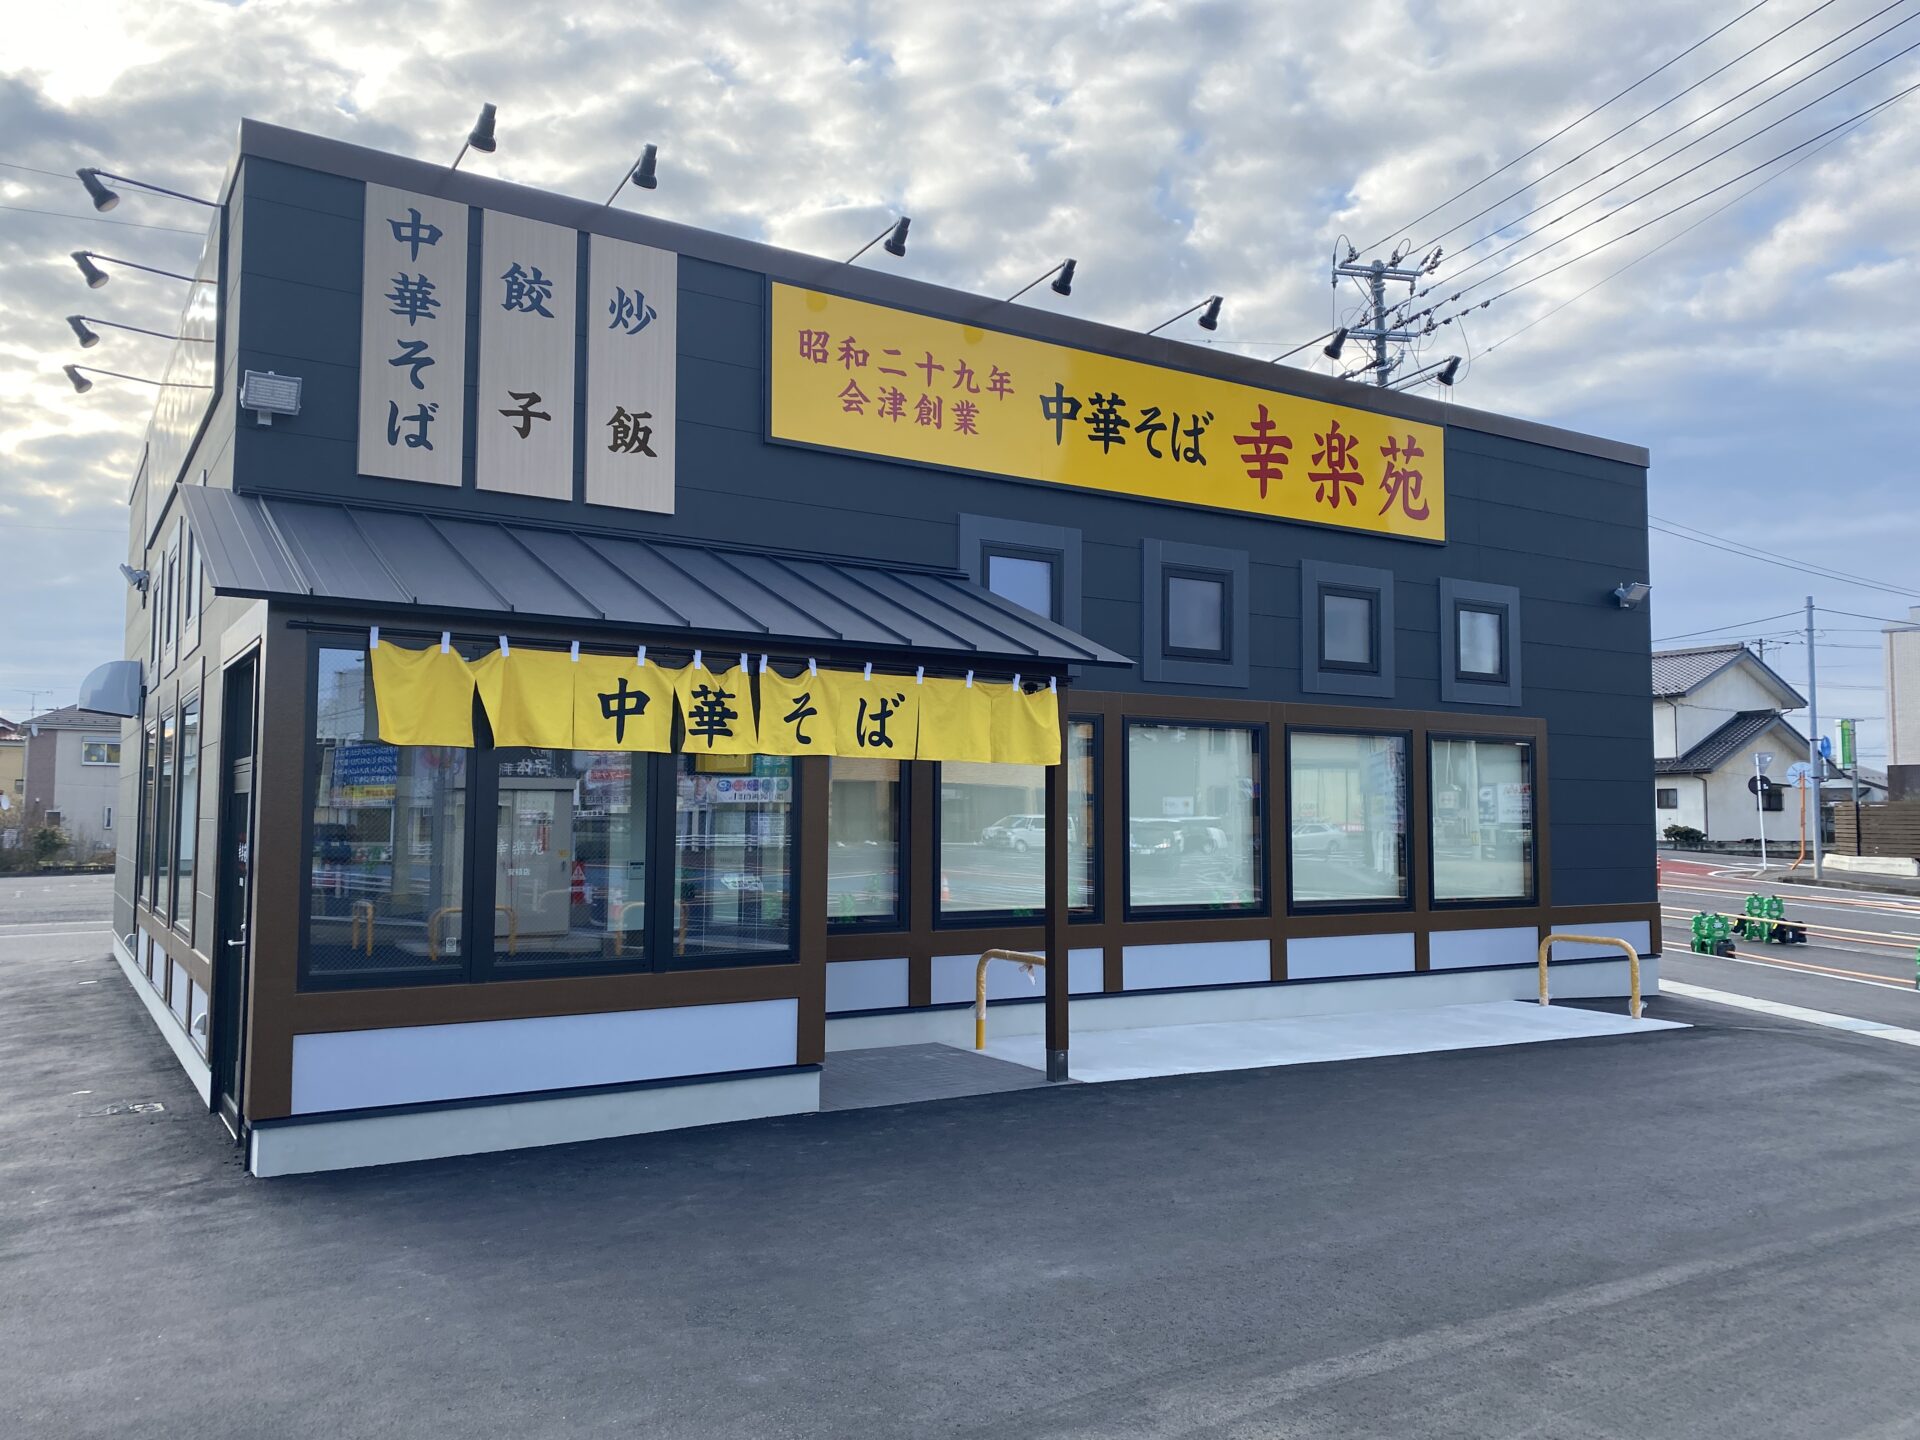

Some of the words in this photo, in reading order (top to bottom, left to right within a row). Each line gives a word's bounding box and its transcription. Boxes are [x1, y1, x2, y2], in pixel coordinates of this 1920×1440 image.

[385, 207, 443, 452] 中華そば
[499, 262, 555, 439] 餃子
[606, 286, 658, 458] 炒飯
[798, 327, 1015, 402] 昭和二十九年
[837, 378, 980, 436] 会津創業
[1039, 382, 1215, 467] 中華そば
[1233, 403, 1431, 522] 幸楽苑
[597, 677, 906, 749] 中華そば
